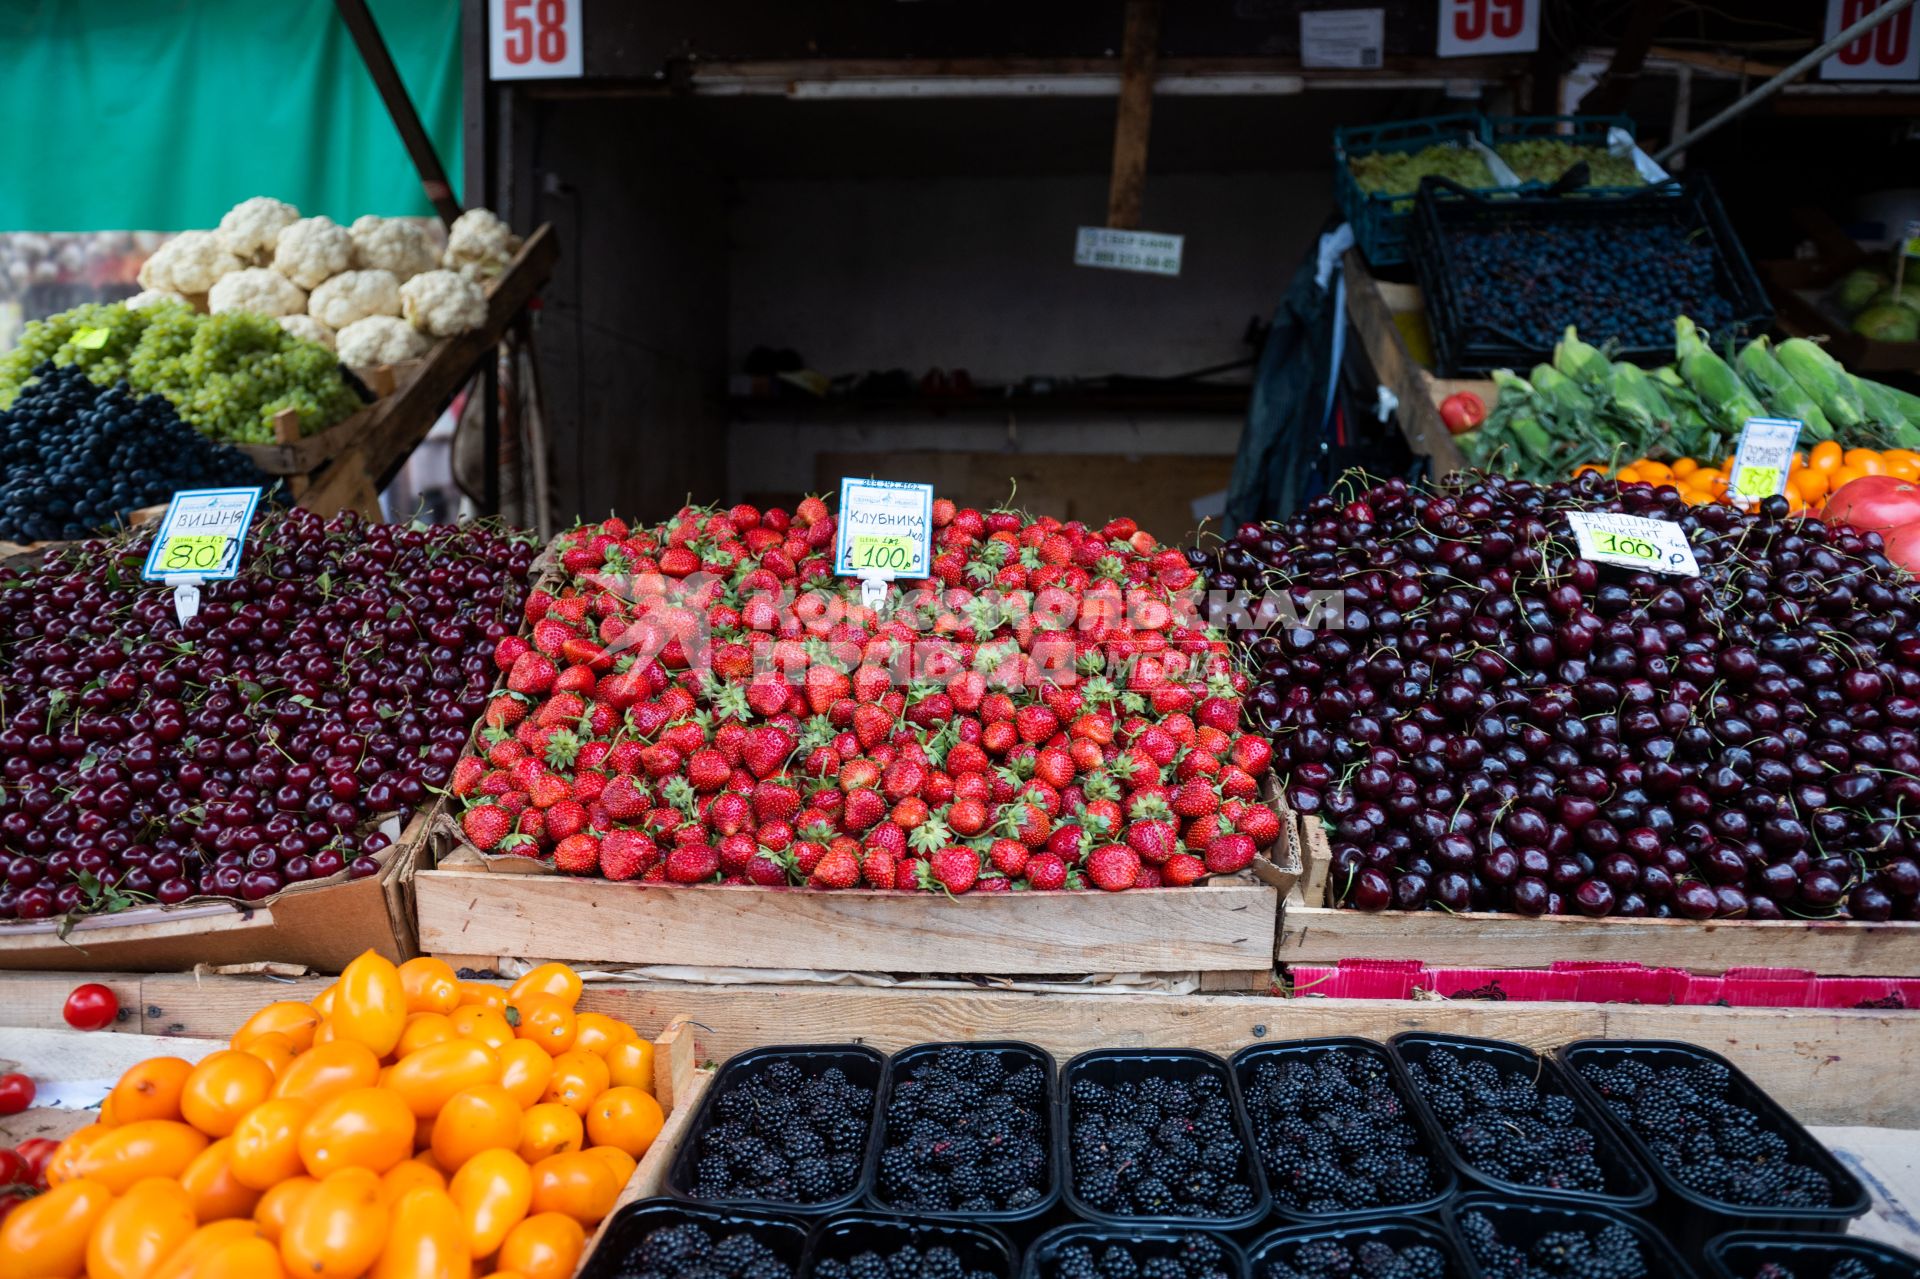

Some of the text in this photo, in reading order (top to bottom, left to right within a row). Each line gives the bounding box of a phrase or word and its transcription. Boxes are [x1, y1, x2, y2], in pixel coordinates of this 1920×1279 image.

[504, 0, 566, 64] 58
[177, 510, 244, 528] ВИШНЯ
[850, 510, 925, 527] КЛУБНИКА
[1573, 512, 1663, 529] ЧЕРЕШНЯ
[1582, 522, 1661, 539] ТАШКЕНТ
